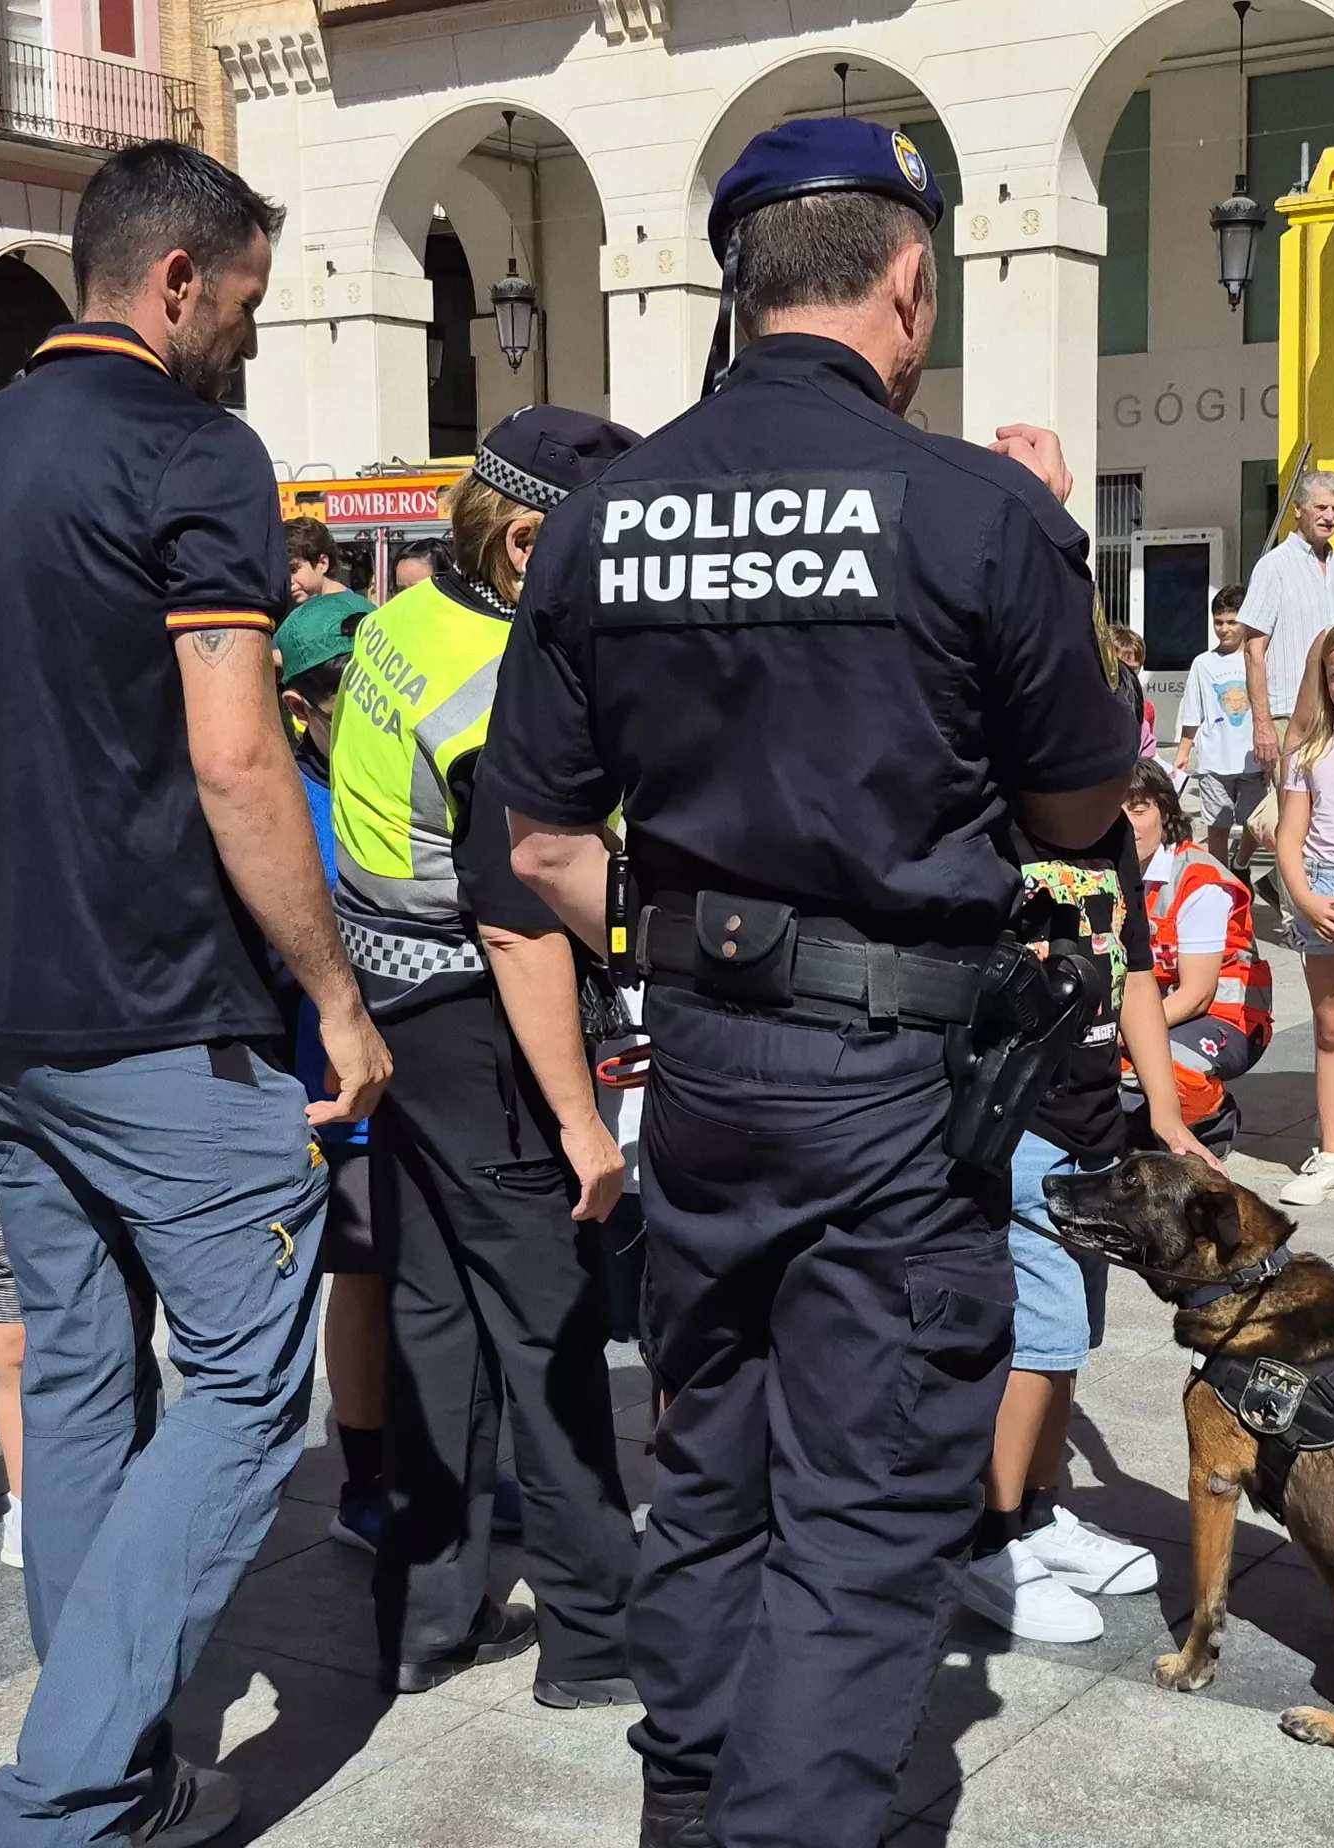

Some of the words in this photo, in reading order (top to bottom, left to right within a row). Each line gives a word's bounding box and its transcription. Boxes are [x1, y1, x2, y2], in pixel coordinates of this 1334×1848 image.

[328, 490, 438, 517] BOMBEROS
[602, 488, 880, 543] POLICIA
[599, 549, 879, 604] HUESCA
[361, 619, 428, 706] POLICIA
[1146, 681, 1185, 693] HUES
